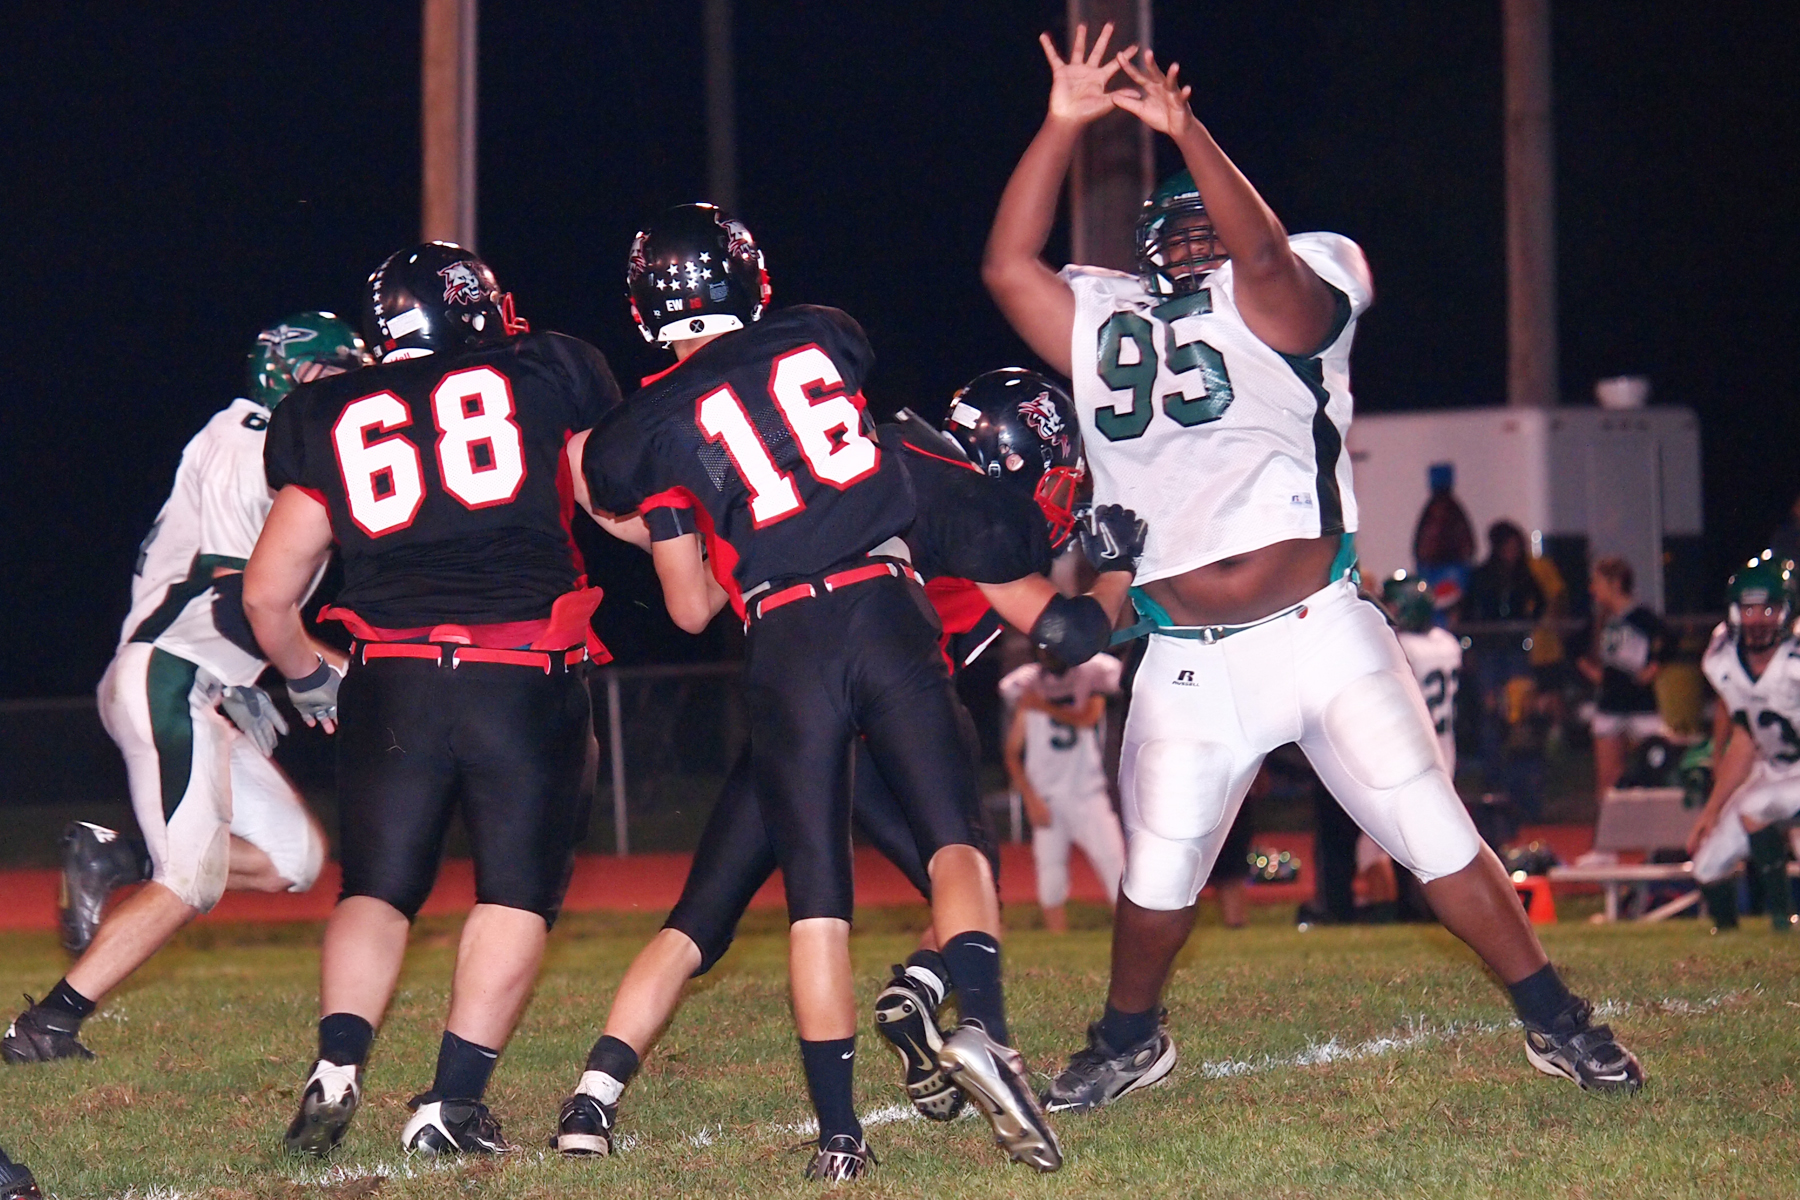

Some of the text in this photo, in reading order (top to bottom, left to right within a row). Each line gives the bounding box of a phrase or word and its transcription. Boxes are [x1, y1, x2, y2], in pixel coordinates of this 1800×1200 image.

[666, 298, 683, 312] EW
[1095, 287, 1235, 442] 95
[330, 364, 528, 540] 68
[694, 342, 881, 530] 16
